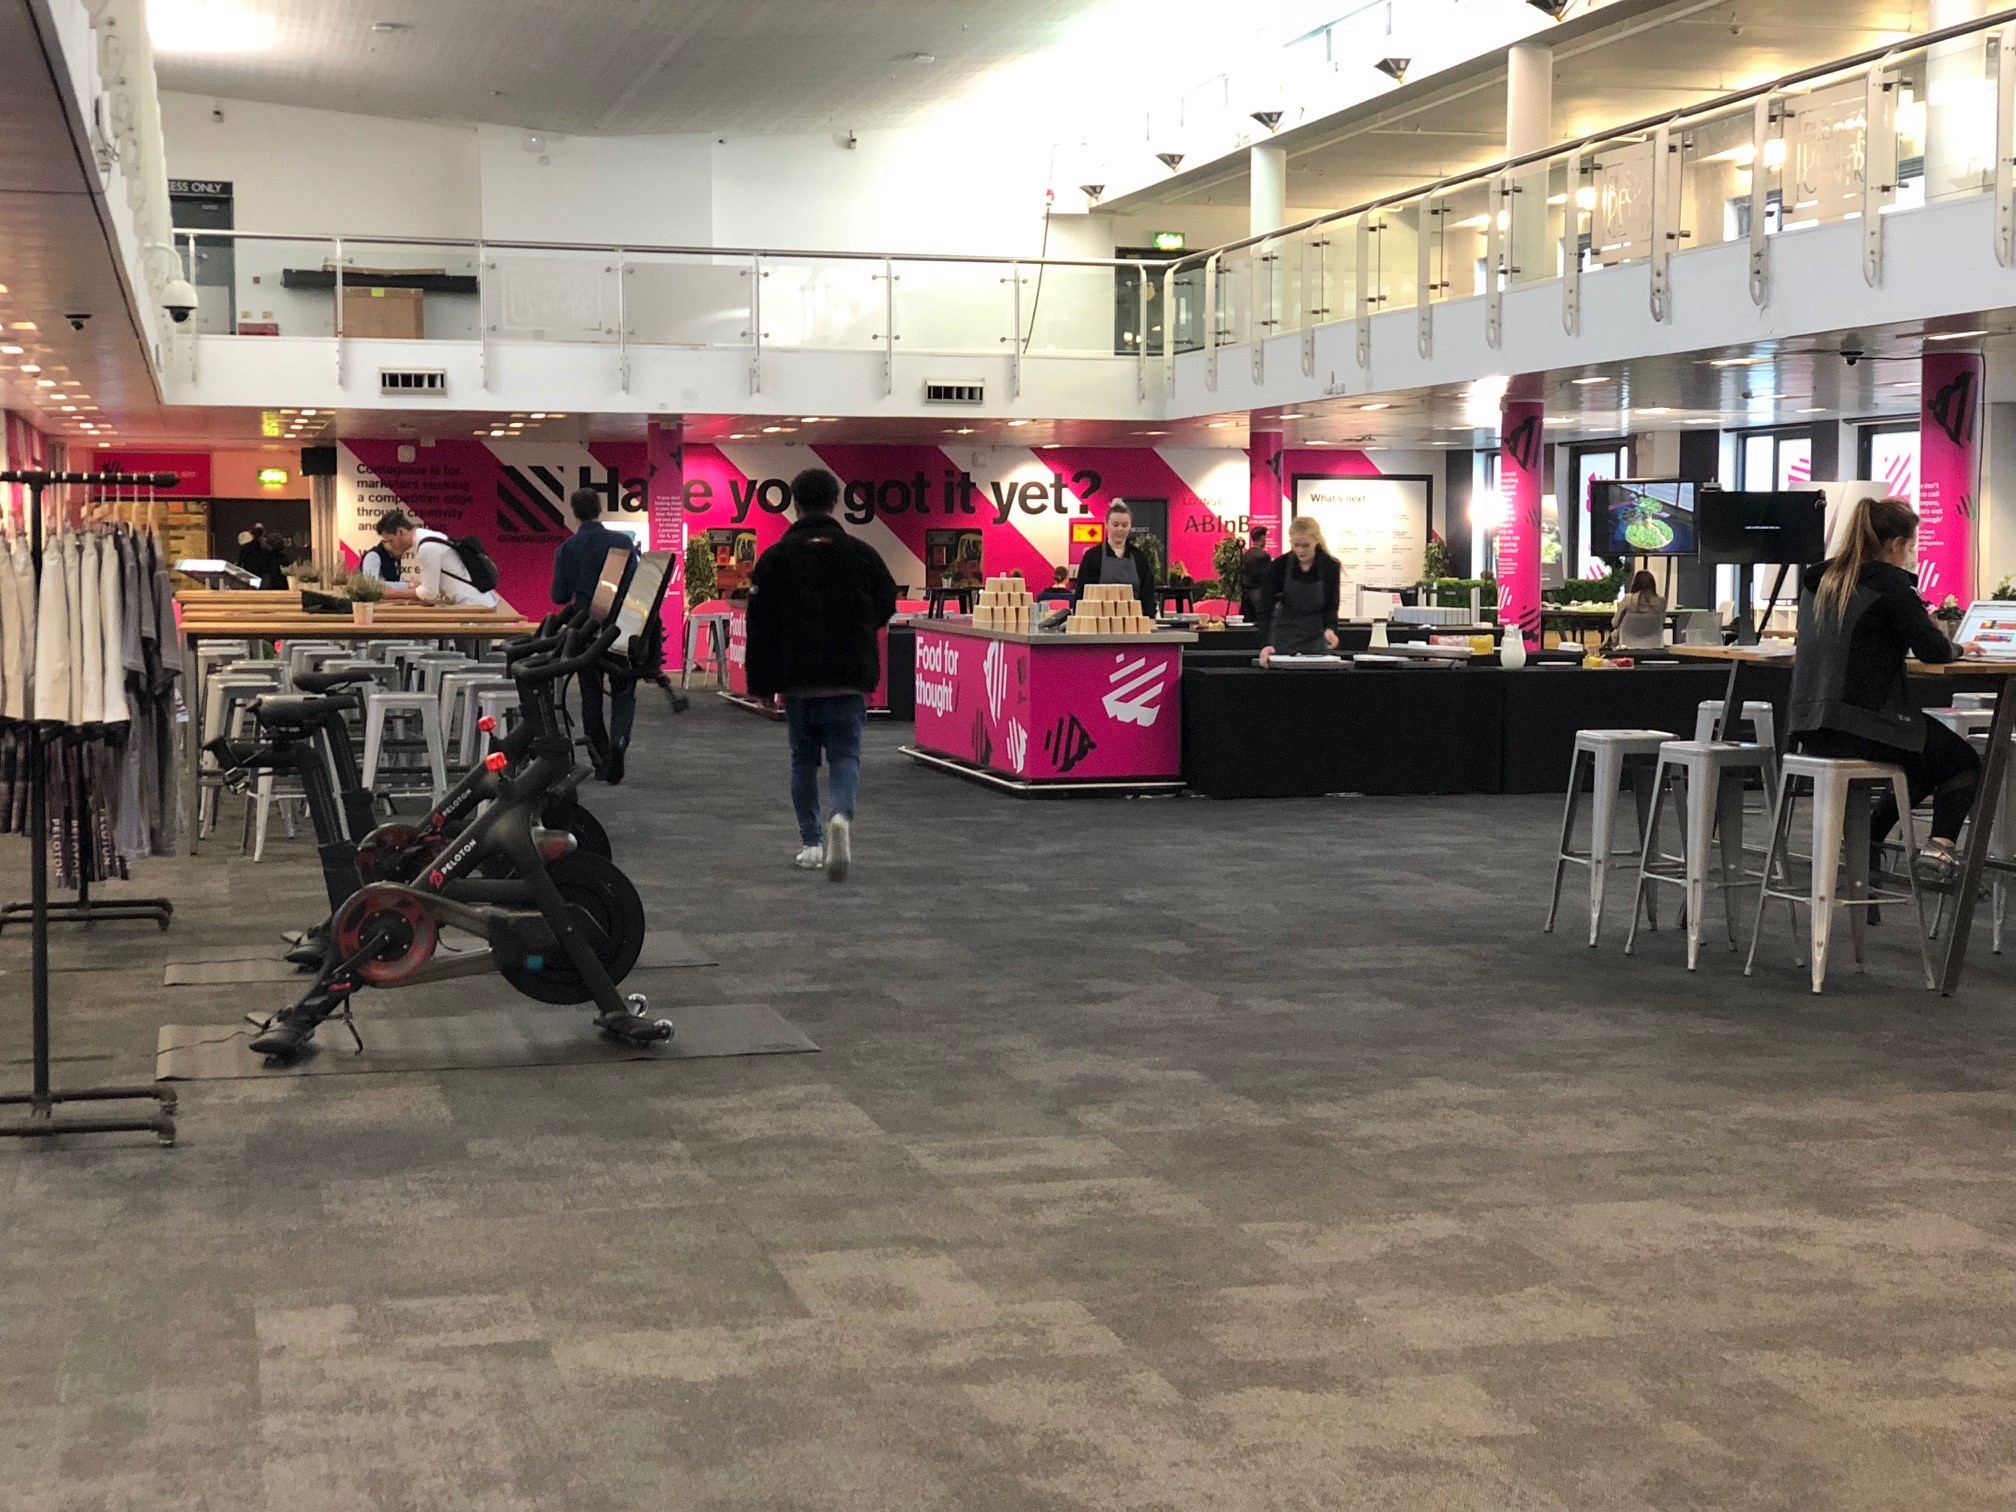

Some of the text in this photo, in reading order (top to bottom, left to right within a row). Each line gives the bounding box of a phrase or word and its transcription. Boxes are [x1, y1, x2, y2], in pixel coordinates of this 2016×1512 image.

[191, 182, 222, 193] ONLY
[356, 463, 427, 476] Contagious
[357, 494, 365, 502] a
[579, 466, 1101, 525] Hae yo got it yet?
[1310, 493, 1343, 502] Whats
[357, 506, 403, 518] throuh
[916, 636, 959, 675] Food for
[915, 672, 953, 717] thought
[441, 788, 472, 817] PELOTON
[51, 818, 63, 877] PELOTON
[440, 838, 477, 875] PELOTON
